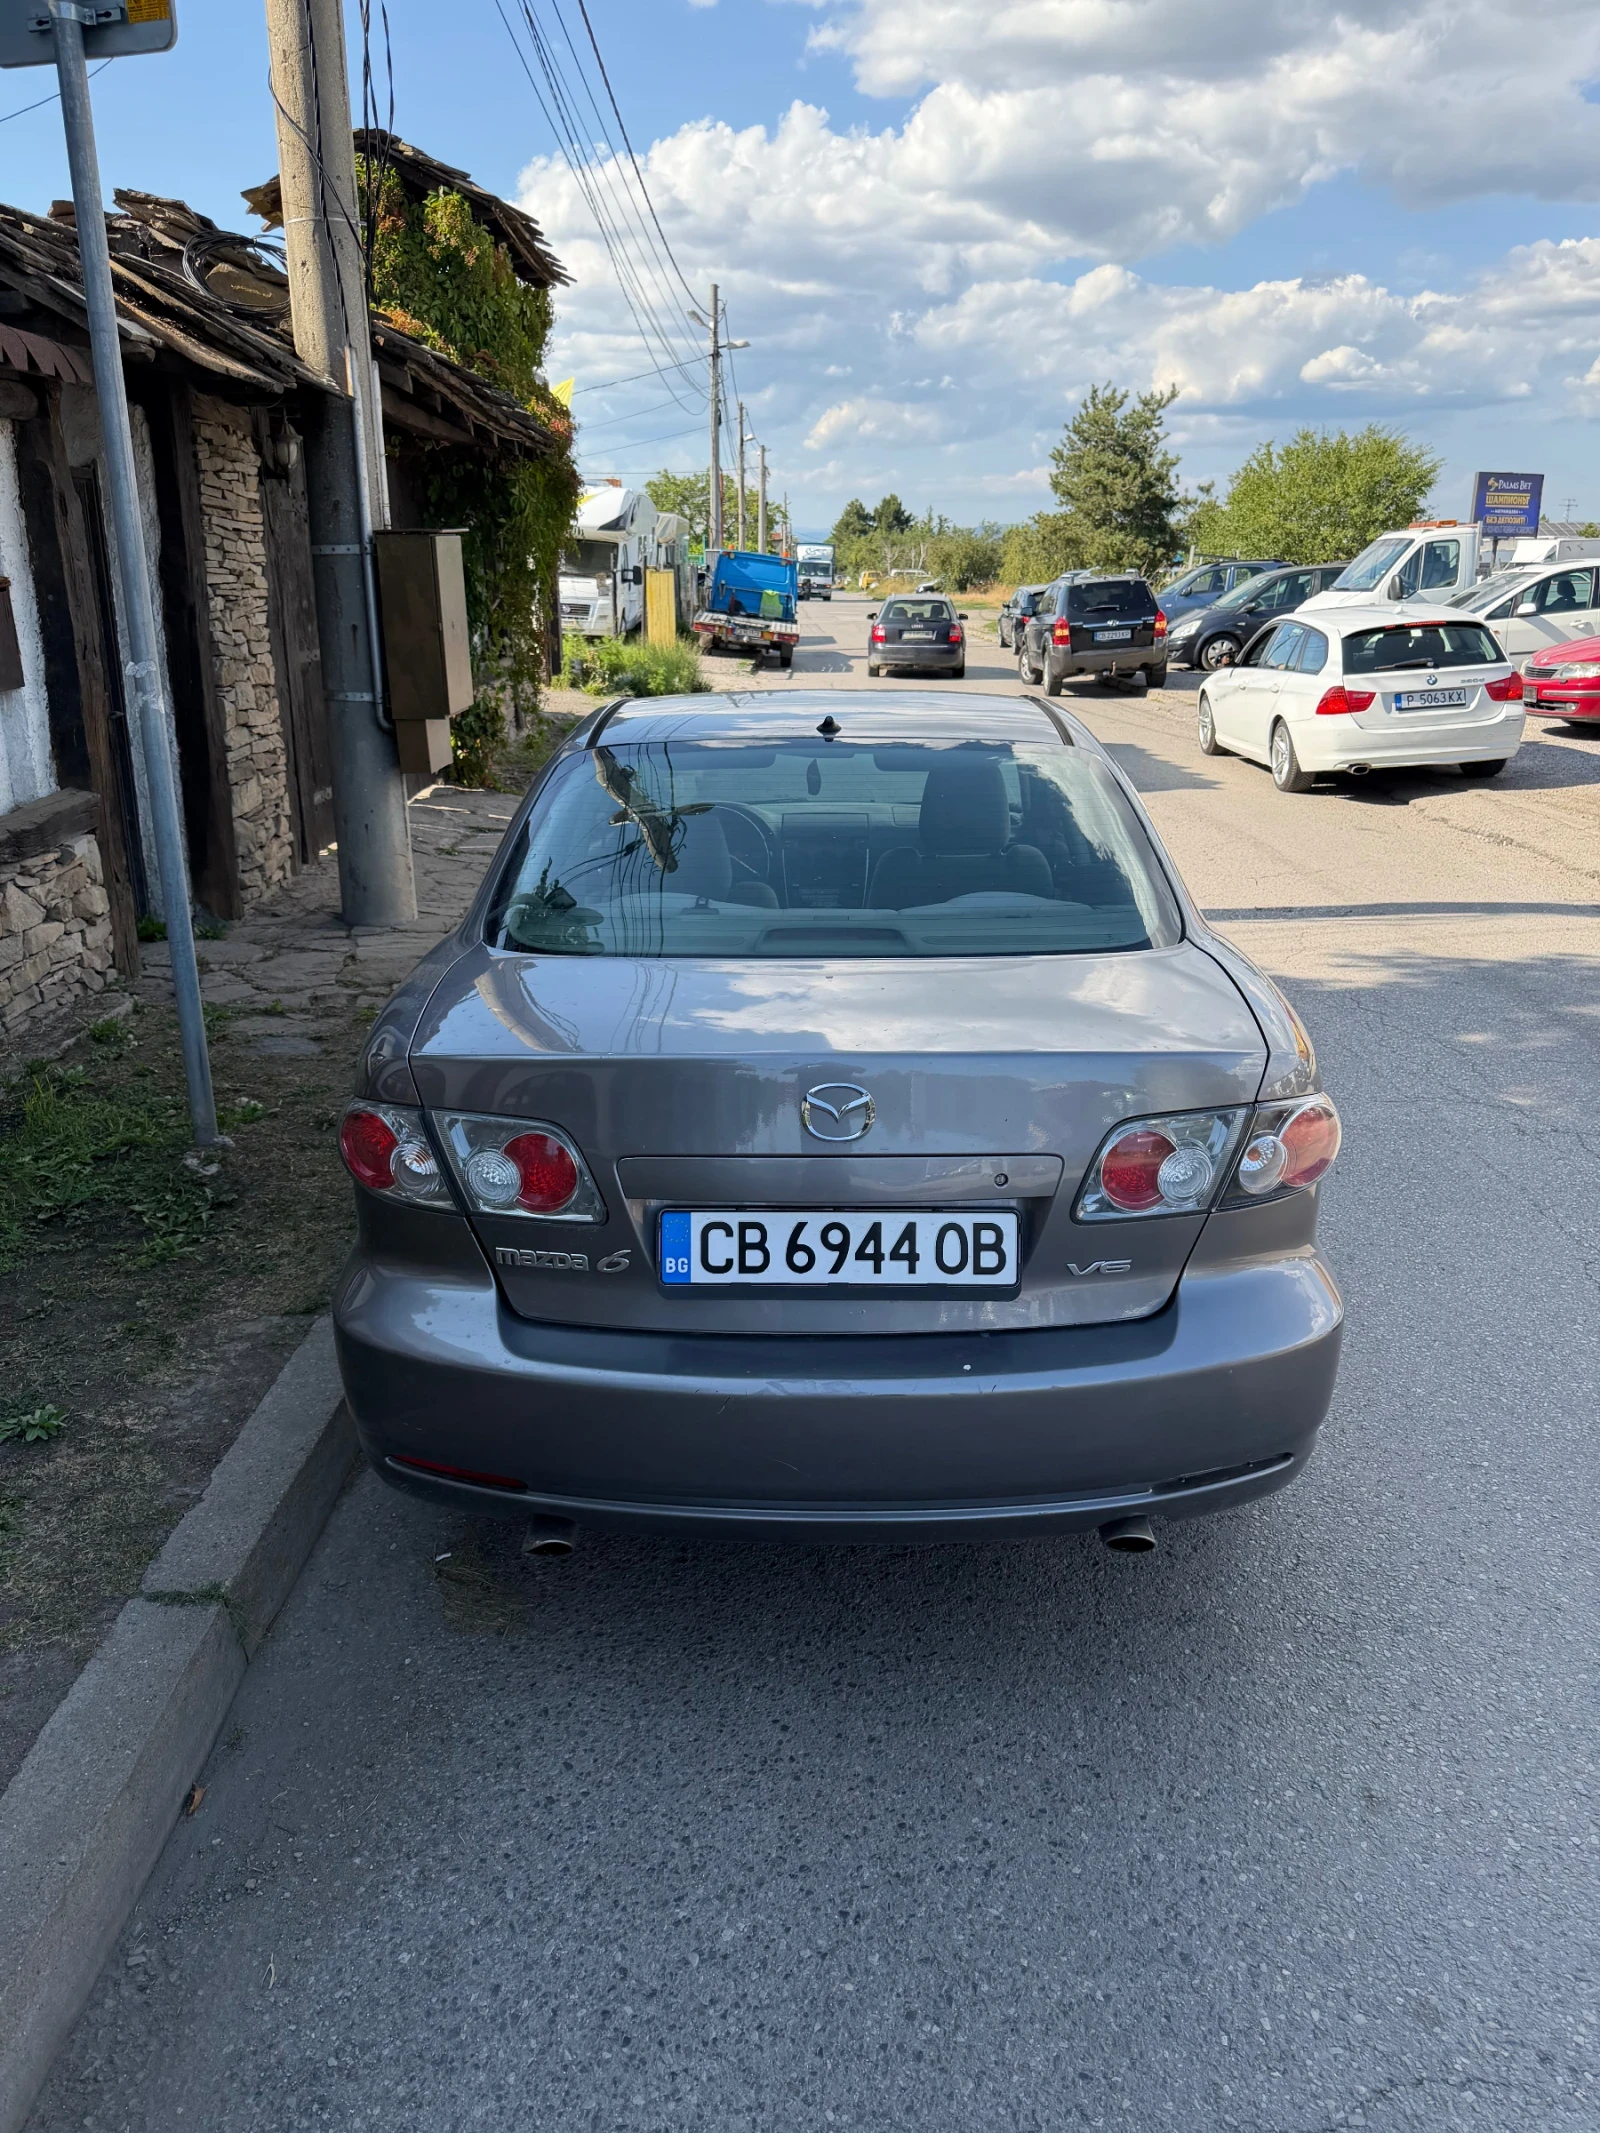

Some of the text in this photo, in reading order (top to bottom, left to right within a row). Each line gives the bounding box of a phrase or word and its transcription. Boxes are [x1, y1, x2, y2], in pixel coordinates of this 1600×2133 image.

[1498, 480, 1532, 490] PALMS BET
[1407, 691, 1463, 706] P 5063 KX
[700, 1221, 1007, 1275] CB 6944 OB
[597, 1249, 632, 1274] 6
[664, 1256, 689, 1274] BG
[1066, 1259, 1132, 1277] V6
